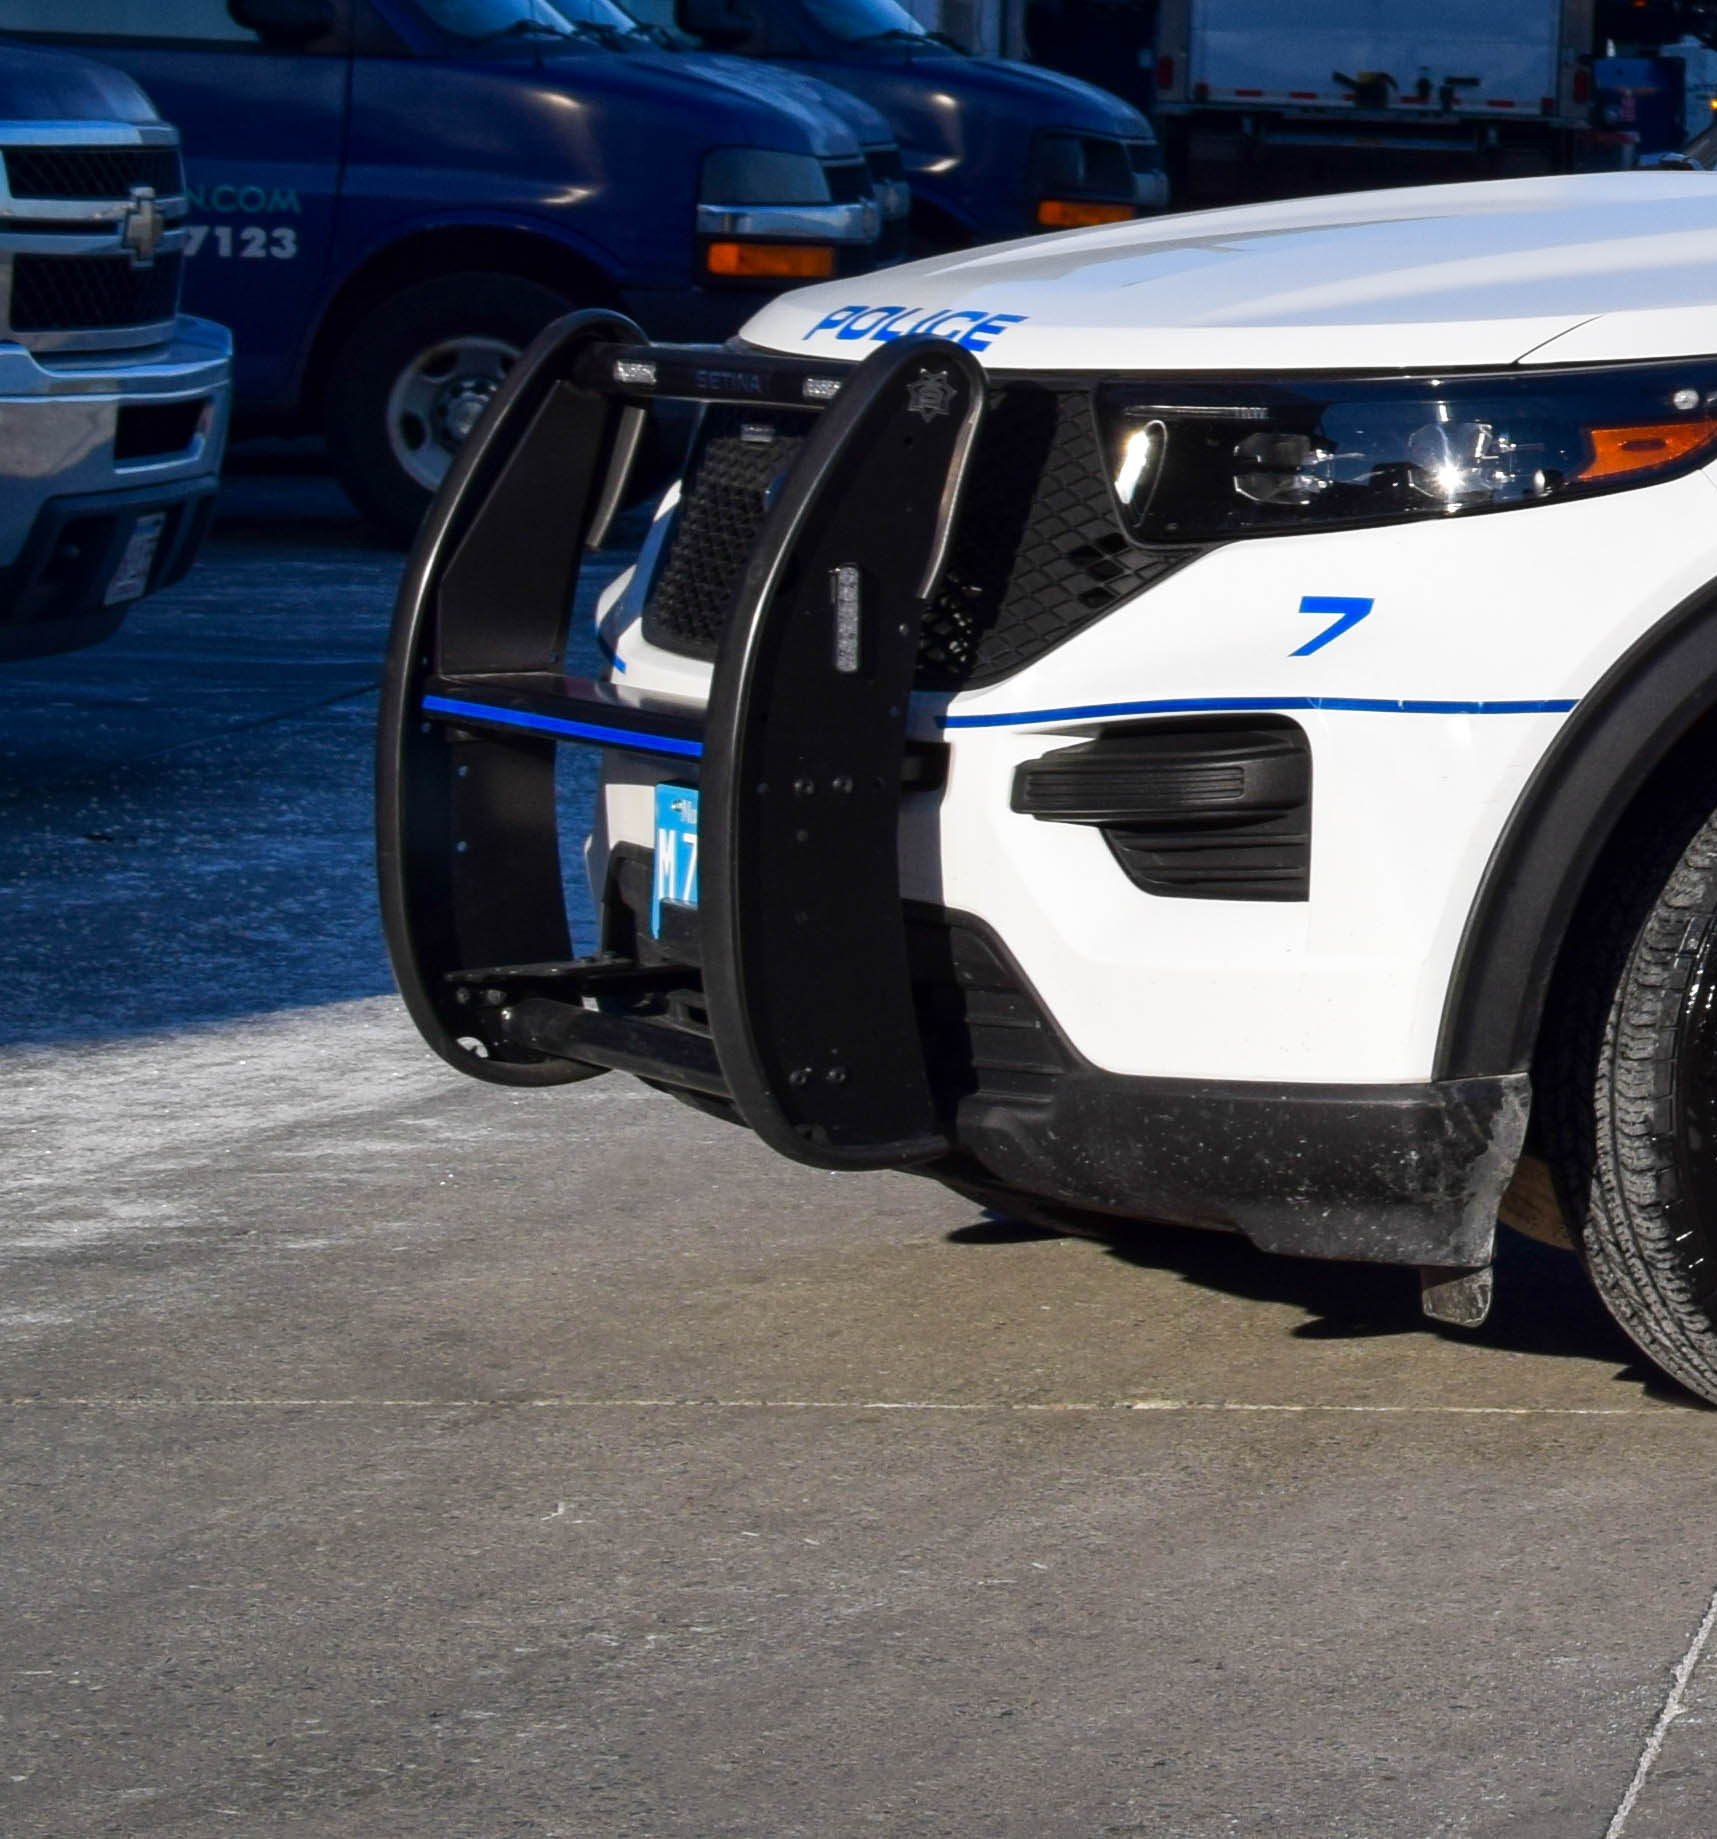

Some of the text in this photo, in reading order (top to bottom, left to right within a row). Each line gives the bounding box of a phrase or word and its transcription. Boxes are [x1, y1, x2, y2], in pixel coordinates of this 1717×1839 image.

[181, 224, 298, 259] 7123
[802, 305, 1029, 352] POLICE
[1287, 595, 1376, 658] 7
